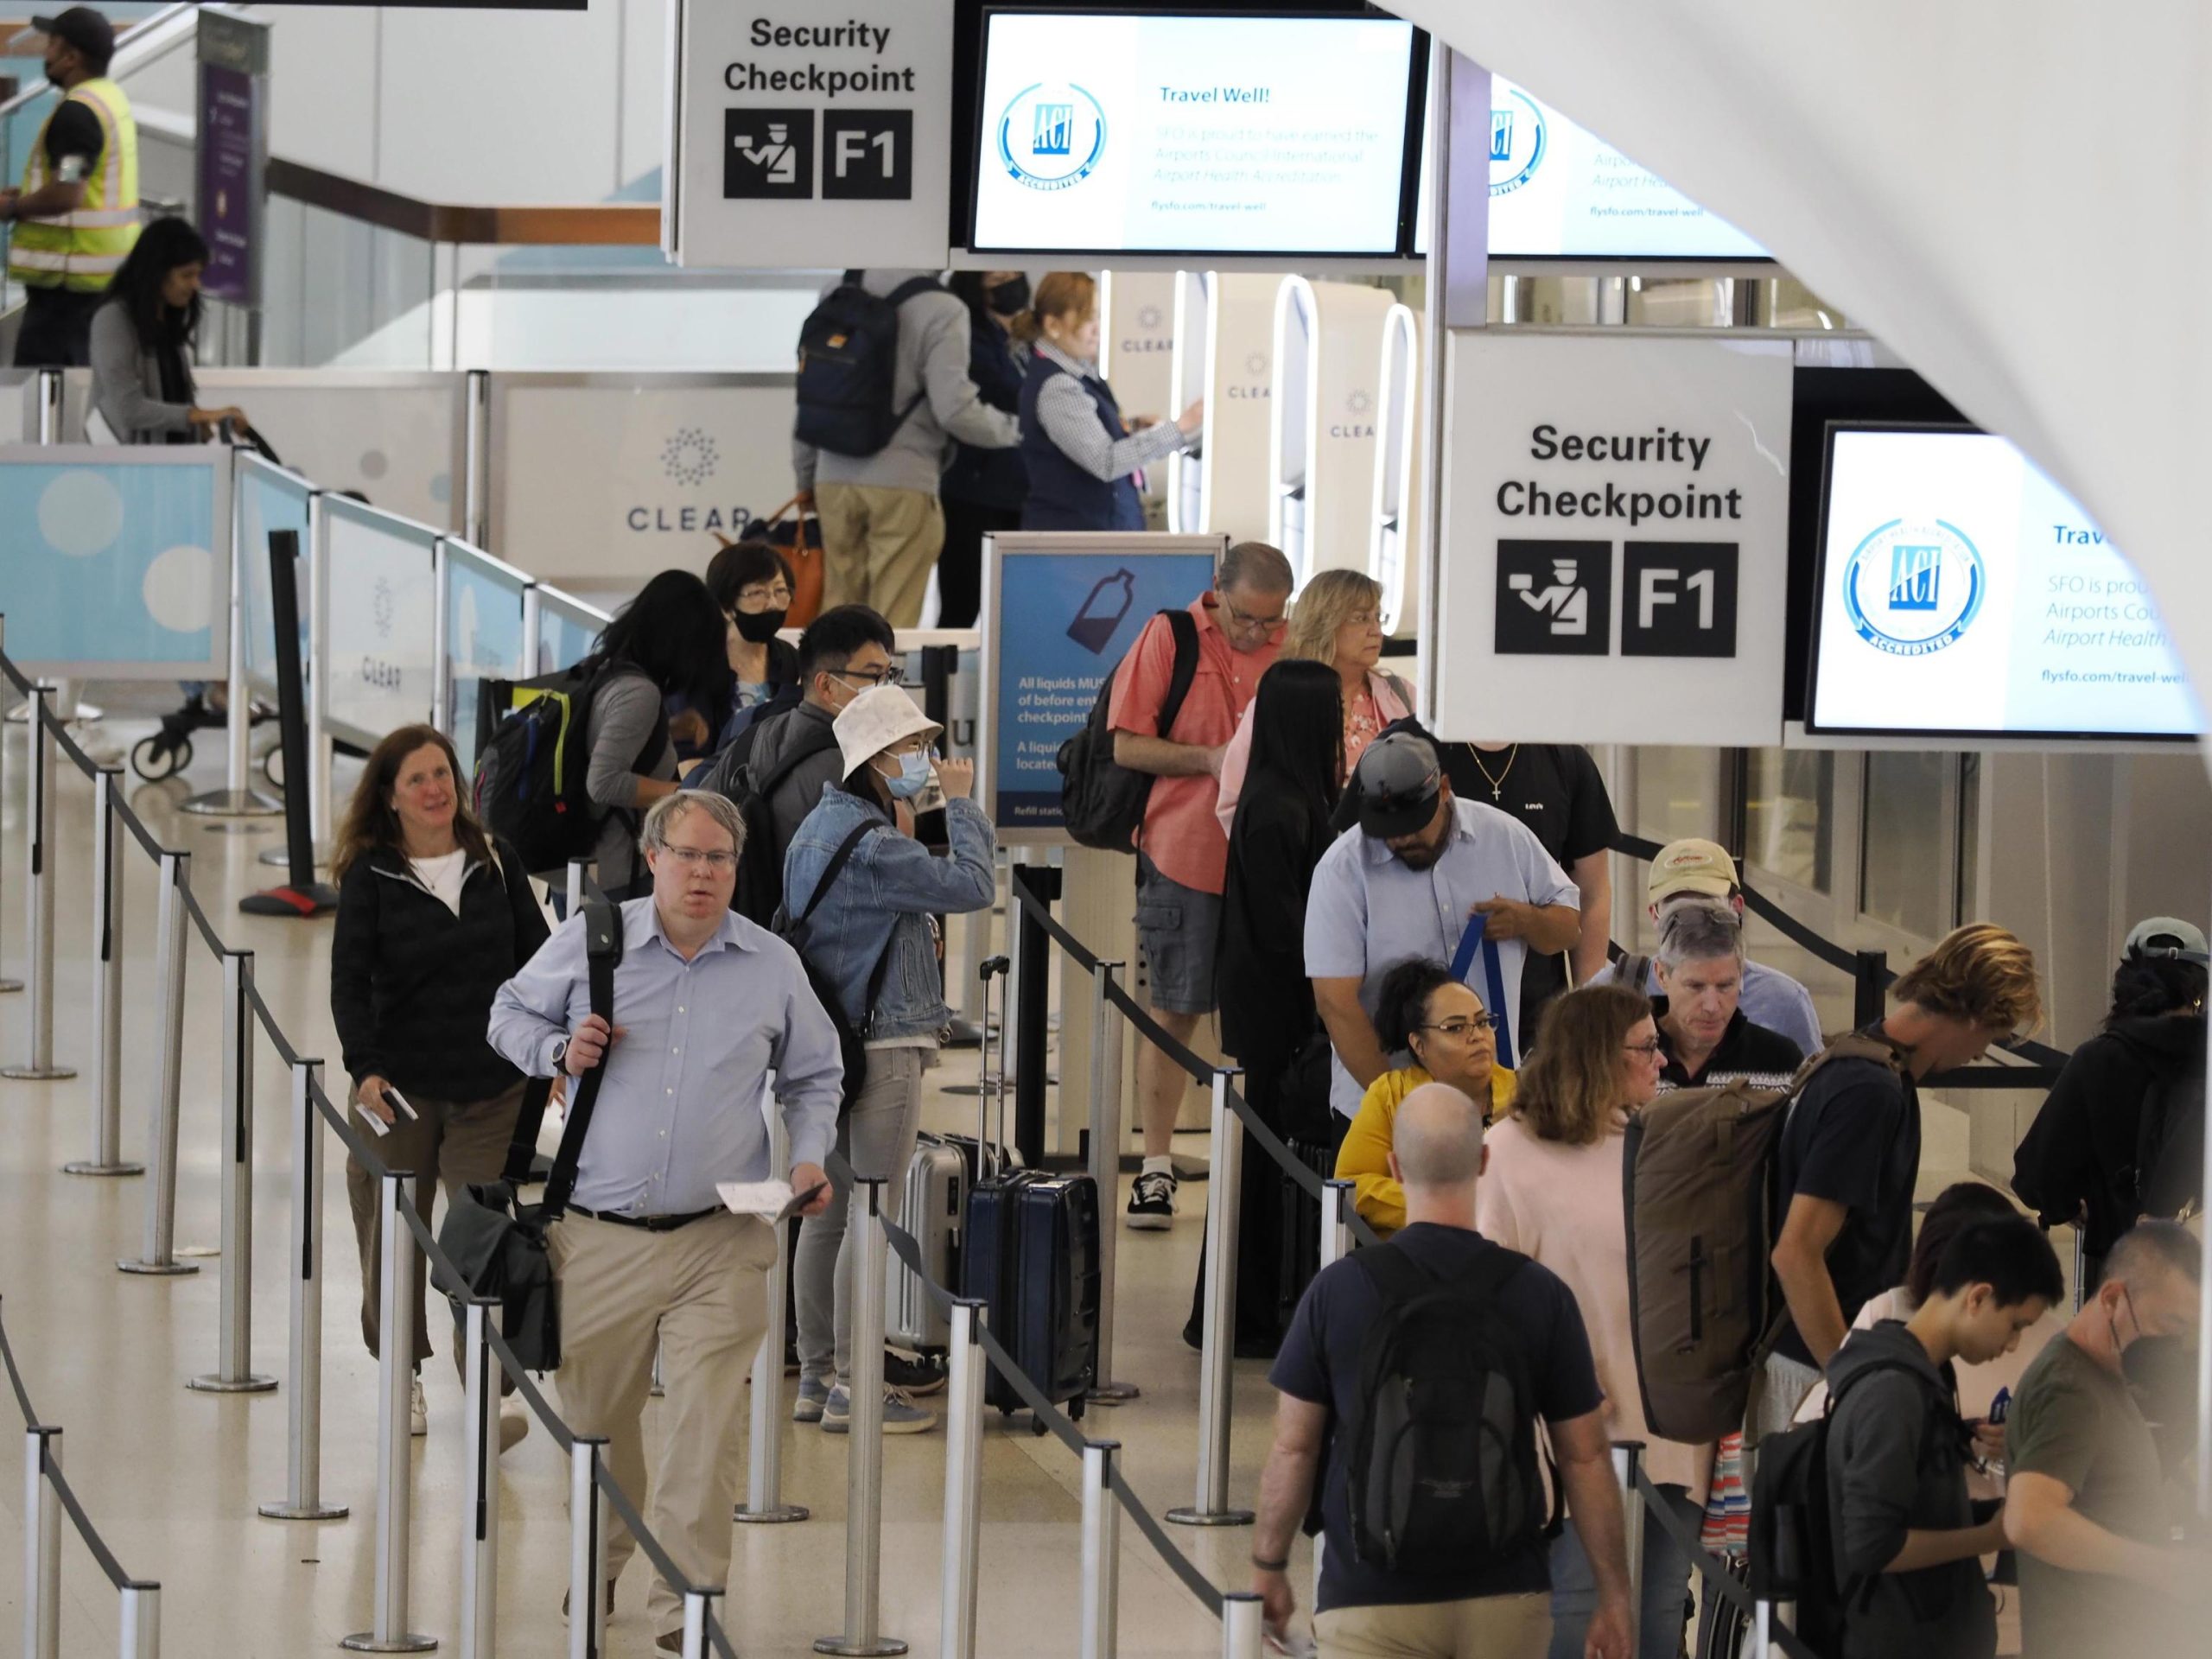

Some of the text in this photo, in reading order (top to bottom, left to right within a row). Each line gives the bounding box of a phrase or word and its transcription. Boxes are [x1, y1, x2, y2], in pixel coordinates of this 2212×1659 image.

[750, 18, 891, 54] Security
[723, 63, 916, 98] Checkpoint
[1160, 87, 1269, 103] Travel Well!
[1033, 105, 1071, 150] ACI
[836, 130, 895, 178] F1
[1530, 424, 1710, 471] Security
[1497, 481, 1742, 526] Checkpoint
[627, 506, 750, 531] CLEAR
[1891, 549, 1939, 603] ACI
[2048, 575, 2084, 593] SFO
[2089, 576, 2101, 594] is
[1639, 568, 1715, 630] F1
[2046, 602, 2118, 622] Airports
[1869, 635, 1954, 657] ACCREDITED
[2042, 628, 2167, 648] Airport Health
[1019, 677, 1034, 689] All
[1037, 677, 1076, 691] liquids
[1019, 694, 1032, 705] of
[1034, 694, 1074, 706] before
[1018, 711, 1087, 725] checkpoint
[1017, 741, 1026, 753] A
[1014, 805, 1037, 816] Refill
